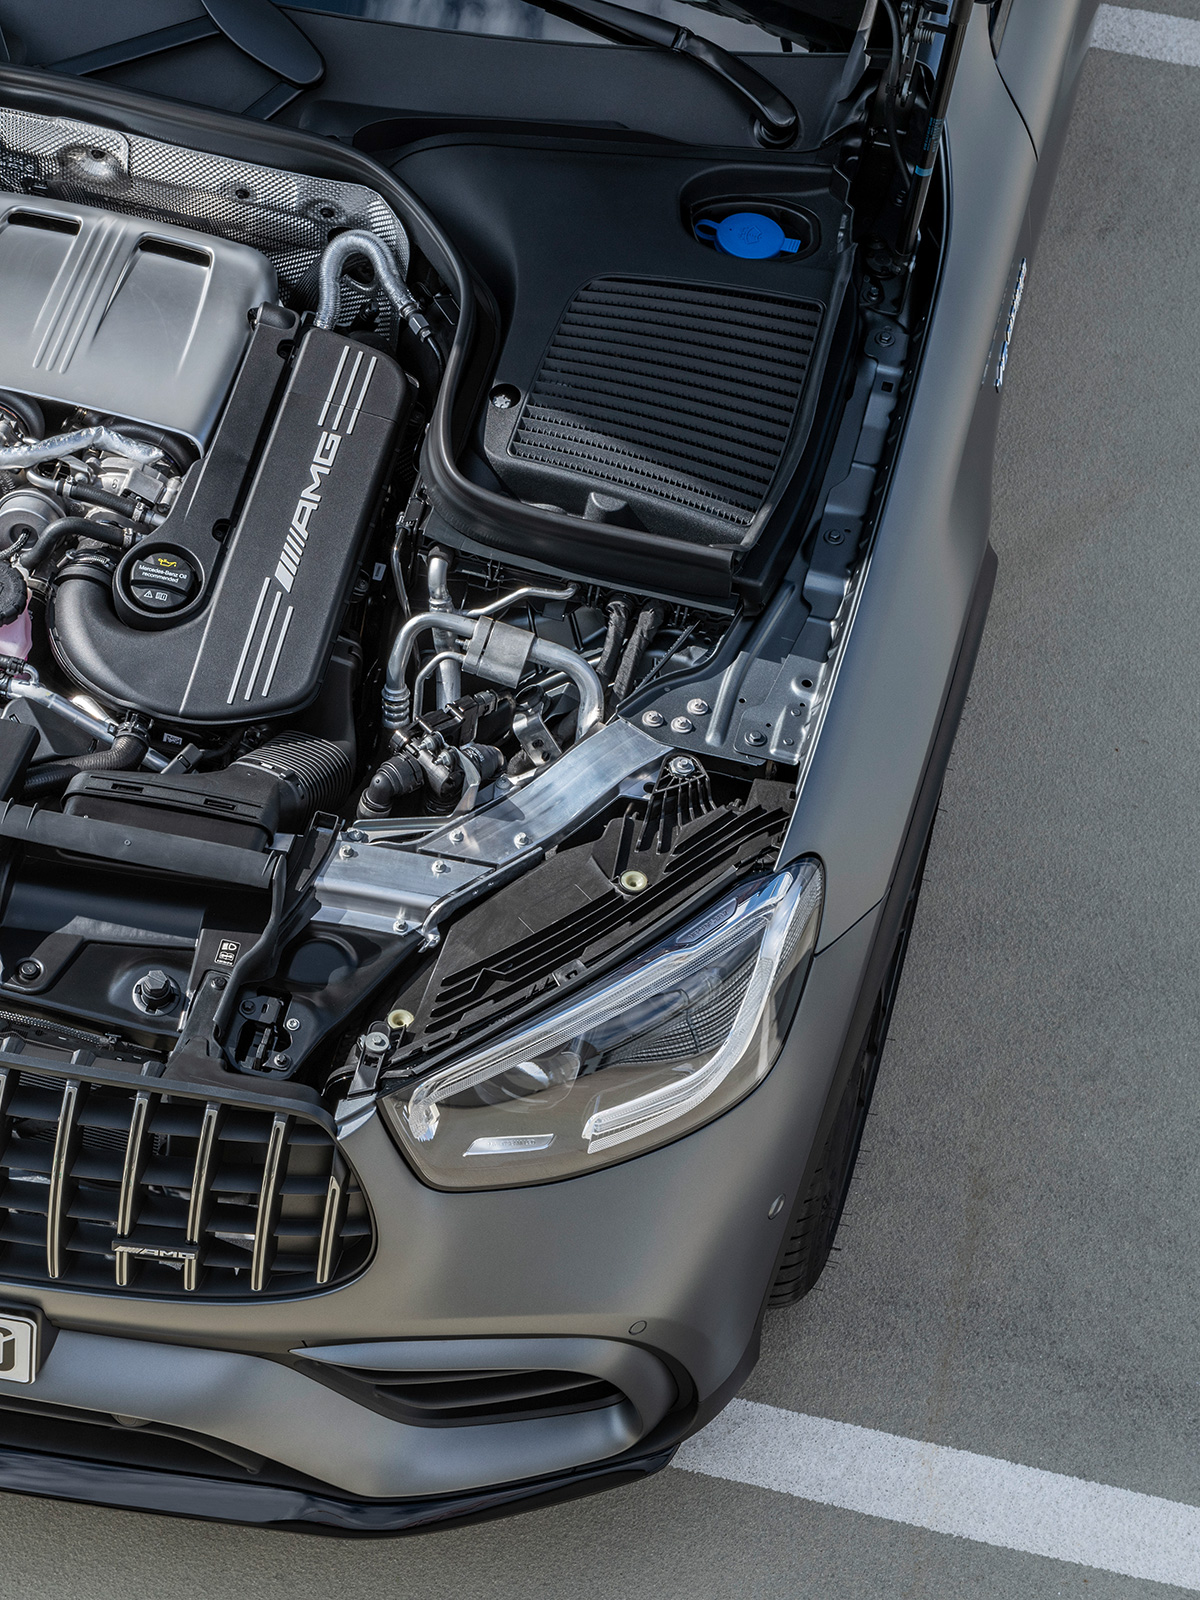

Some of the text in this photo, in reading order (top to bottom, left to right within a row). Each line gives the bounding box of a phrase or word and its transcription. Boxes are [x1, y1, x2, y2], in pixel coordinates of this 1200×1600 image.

[291, 431, 342, 541] AMG
[138, 564, 178, 578] Mercedes-Benz
[141, 571, 179, 584] recommended
[140, 1248, 196, 1260] AMG
